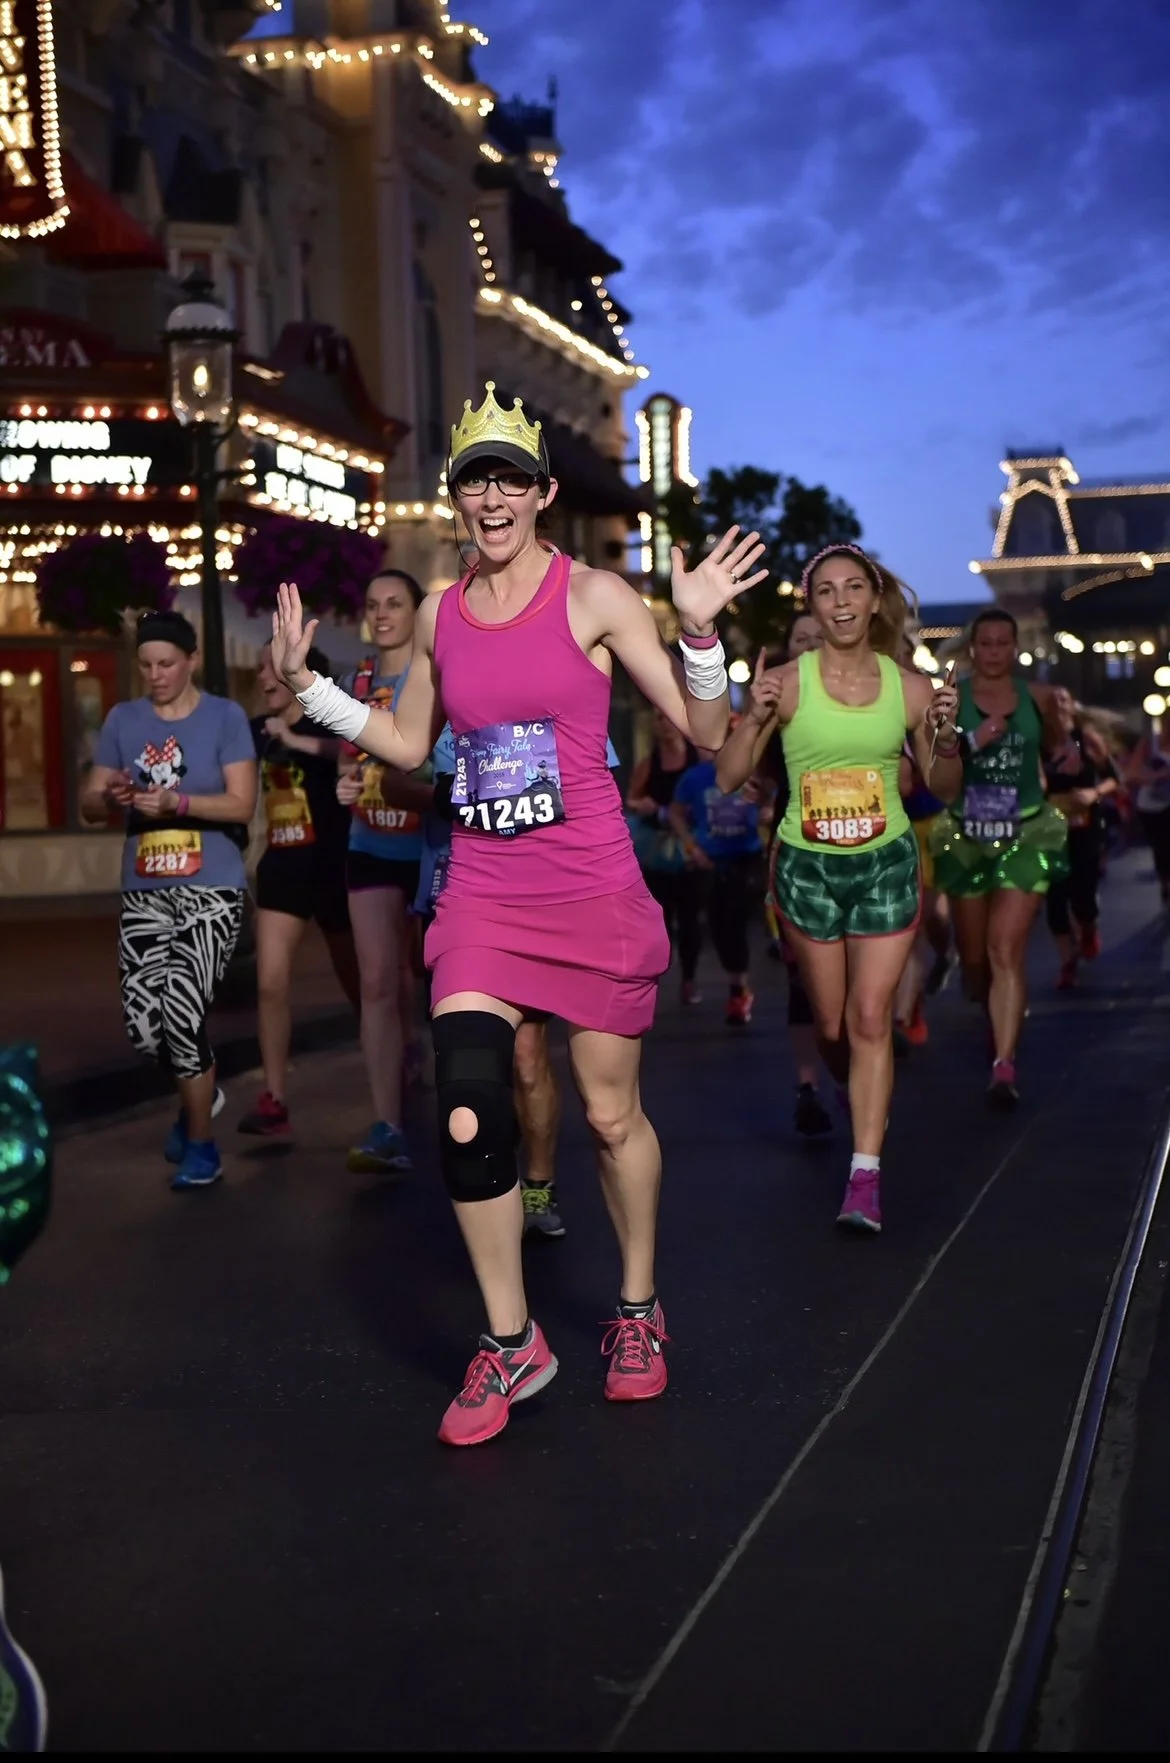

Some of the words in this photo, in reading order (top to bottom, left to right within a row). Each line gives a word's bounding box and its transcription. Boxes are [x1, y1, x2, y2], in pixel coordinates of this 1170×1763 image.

[513, 723, 545, 738] B/C
[487, 743, 511, 759] Fairy
[511, 739, 531, 752] Tale
[456, 757, 467, 796] 21243
[478, 757, 524, 776] Challenge
[366, 808, 408, 828] 1807
[459, 793, 555, 831] 21243
[815, 818, 873, 841] 3083
[145, 852, 188, 873] 2287
